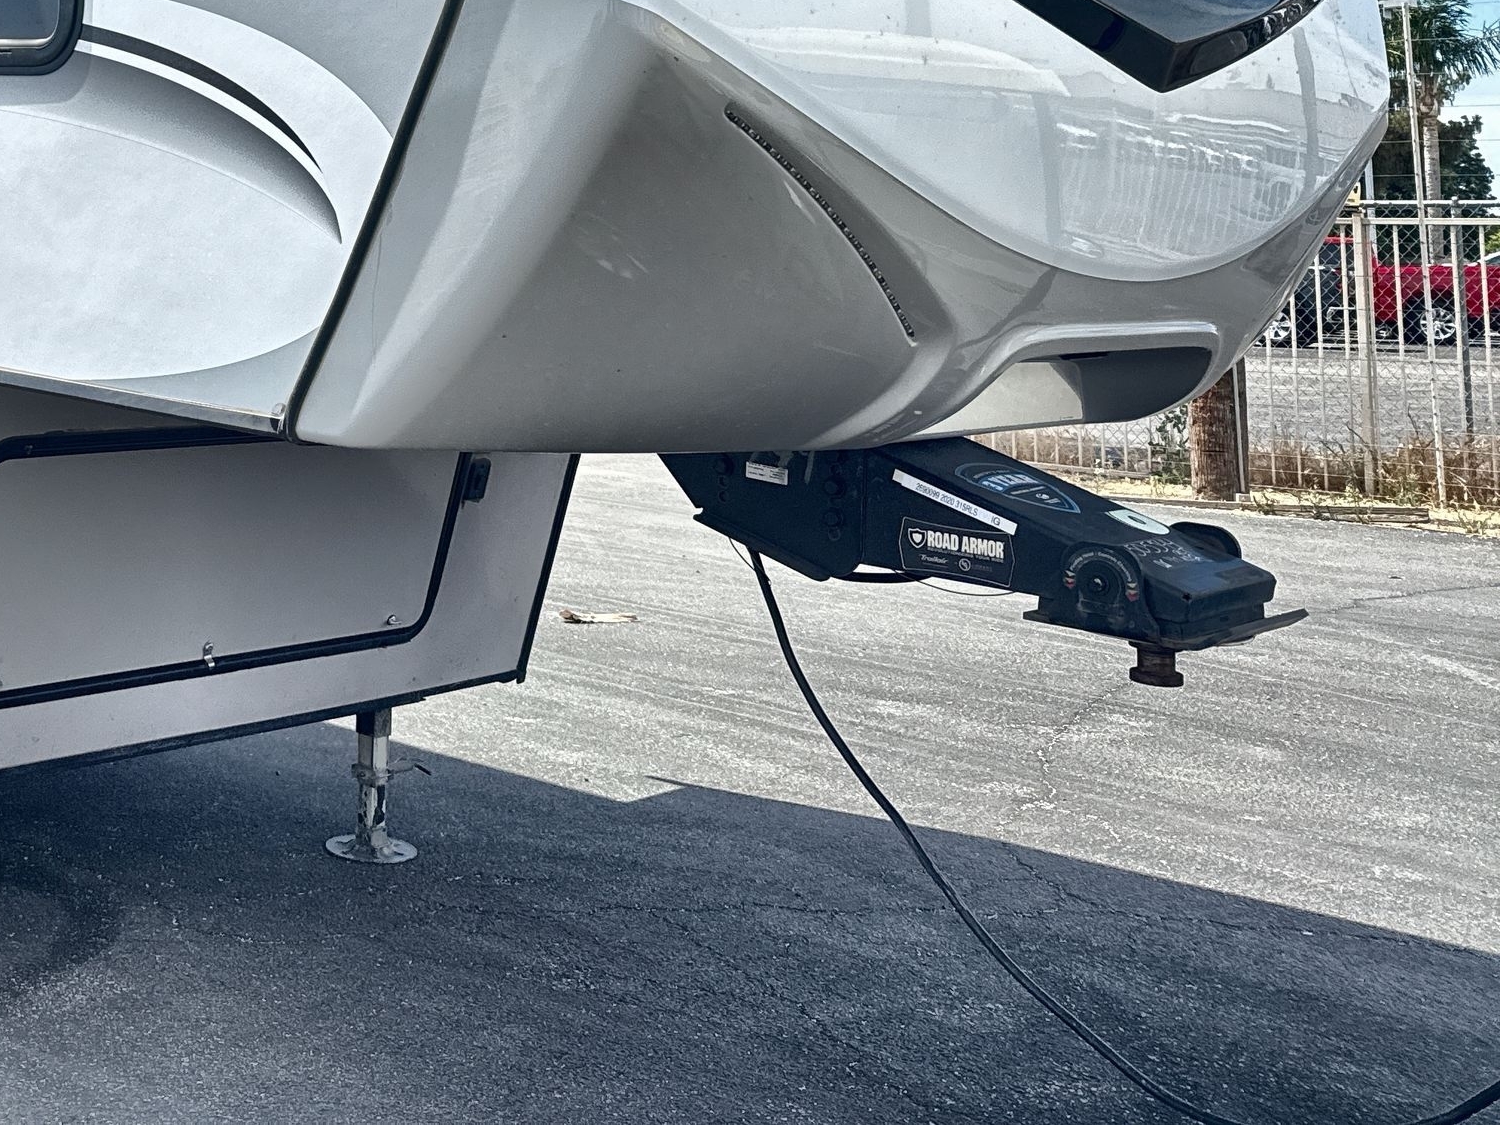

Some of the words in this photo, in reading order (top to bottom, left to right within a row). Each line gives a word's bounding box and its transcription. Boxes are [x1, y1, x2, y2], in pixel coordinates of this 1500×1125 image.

[940, 494, 956, 506] 2020
[927, 530, 959, 551] ROAD
[961, 535, 1005, 559] ARMOR
